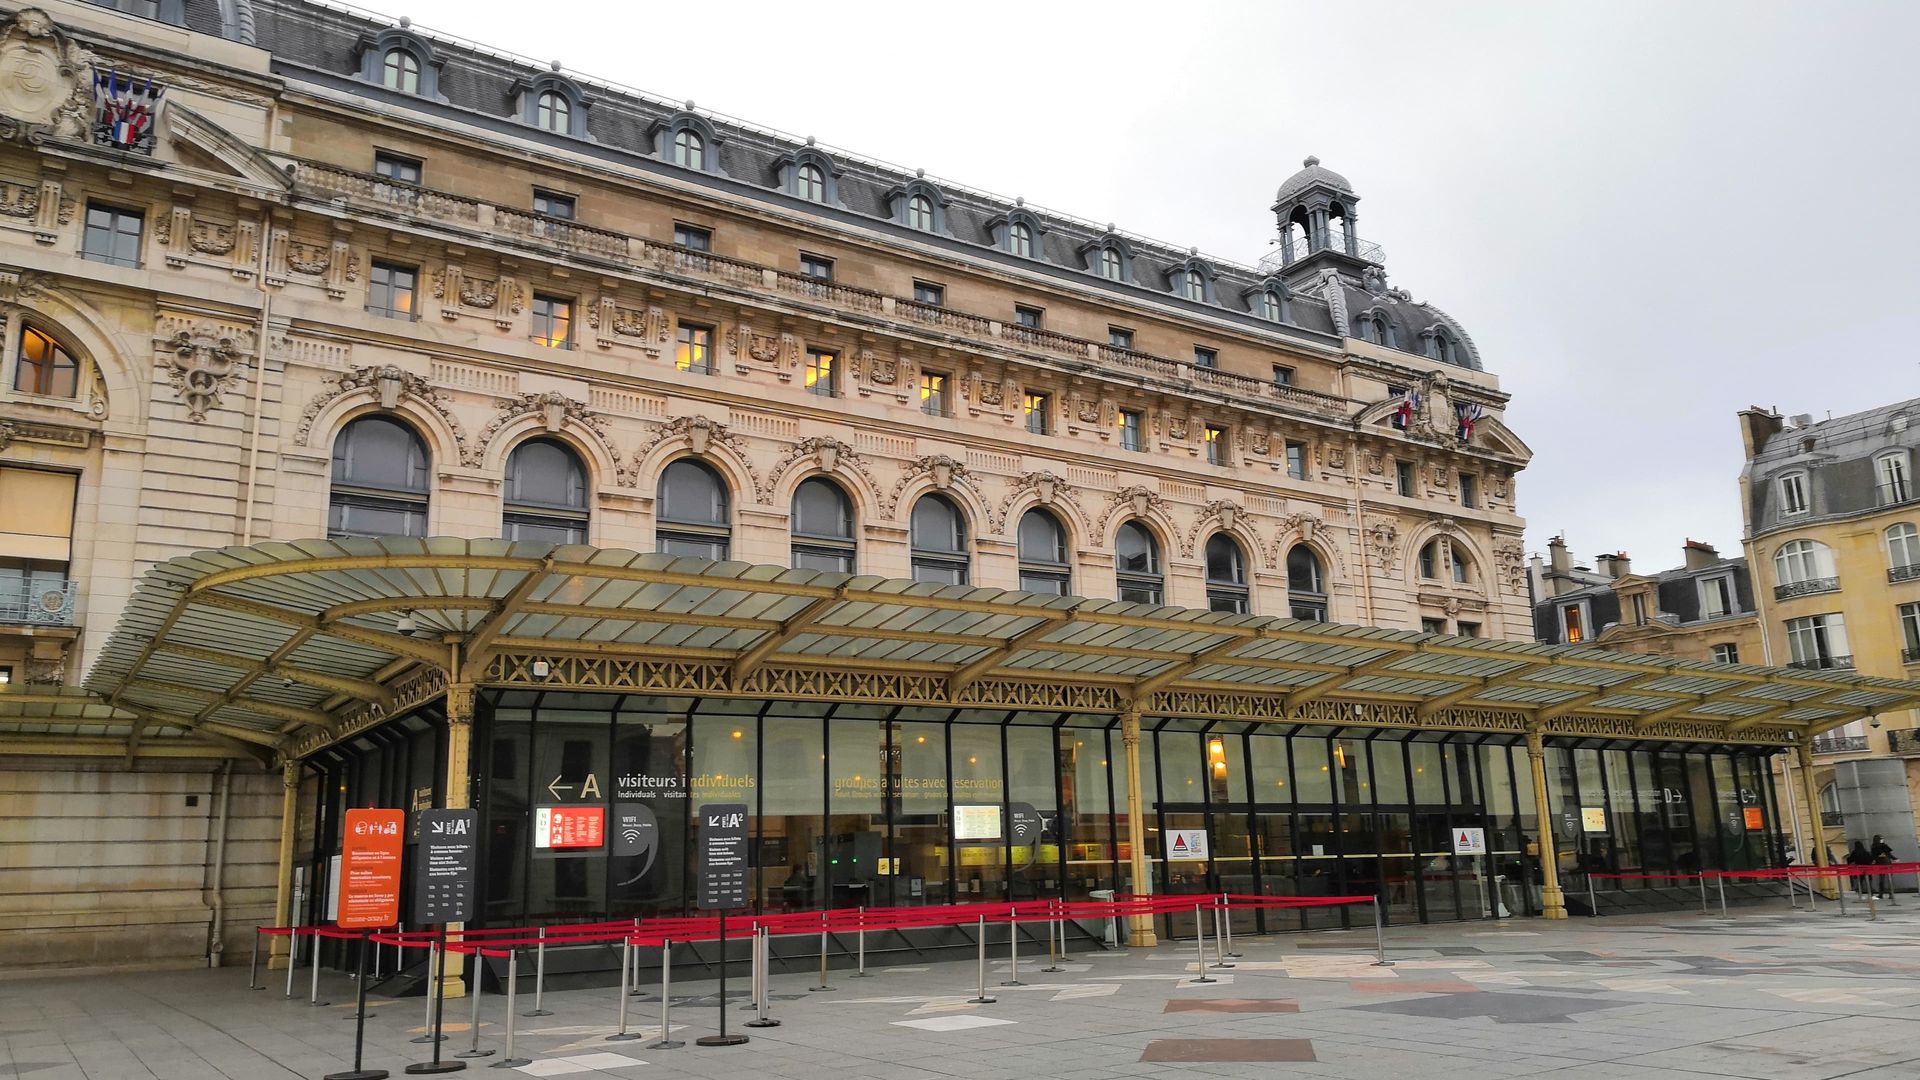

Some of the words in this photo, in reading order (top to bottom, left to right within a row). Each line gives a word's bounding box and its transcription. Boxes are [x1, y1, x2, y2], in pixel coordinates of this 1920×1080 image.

[580, 773, 602, 799] A
[617, 773, 677, 788] visiteurs
[681, 773, 756, 788] individuels
[922, 778, 945, 788] avec
[617, 790, 657, 799] Individuals
[1663, 787, 1672, 803] D
